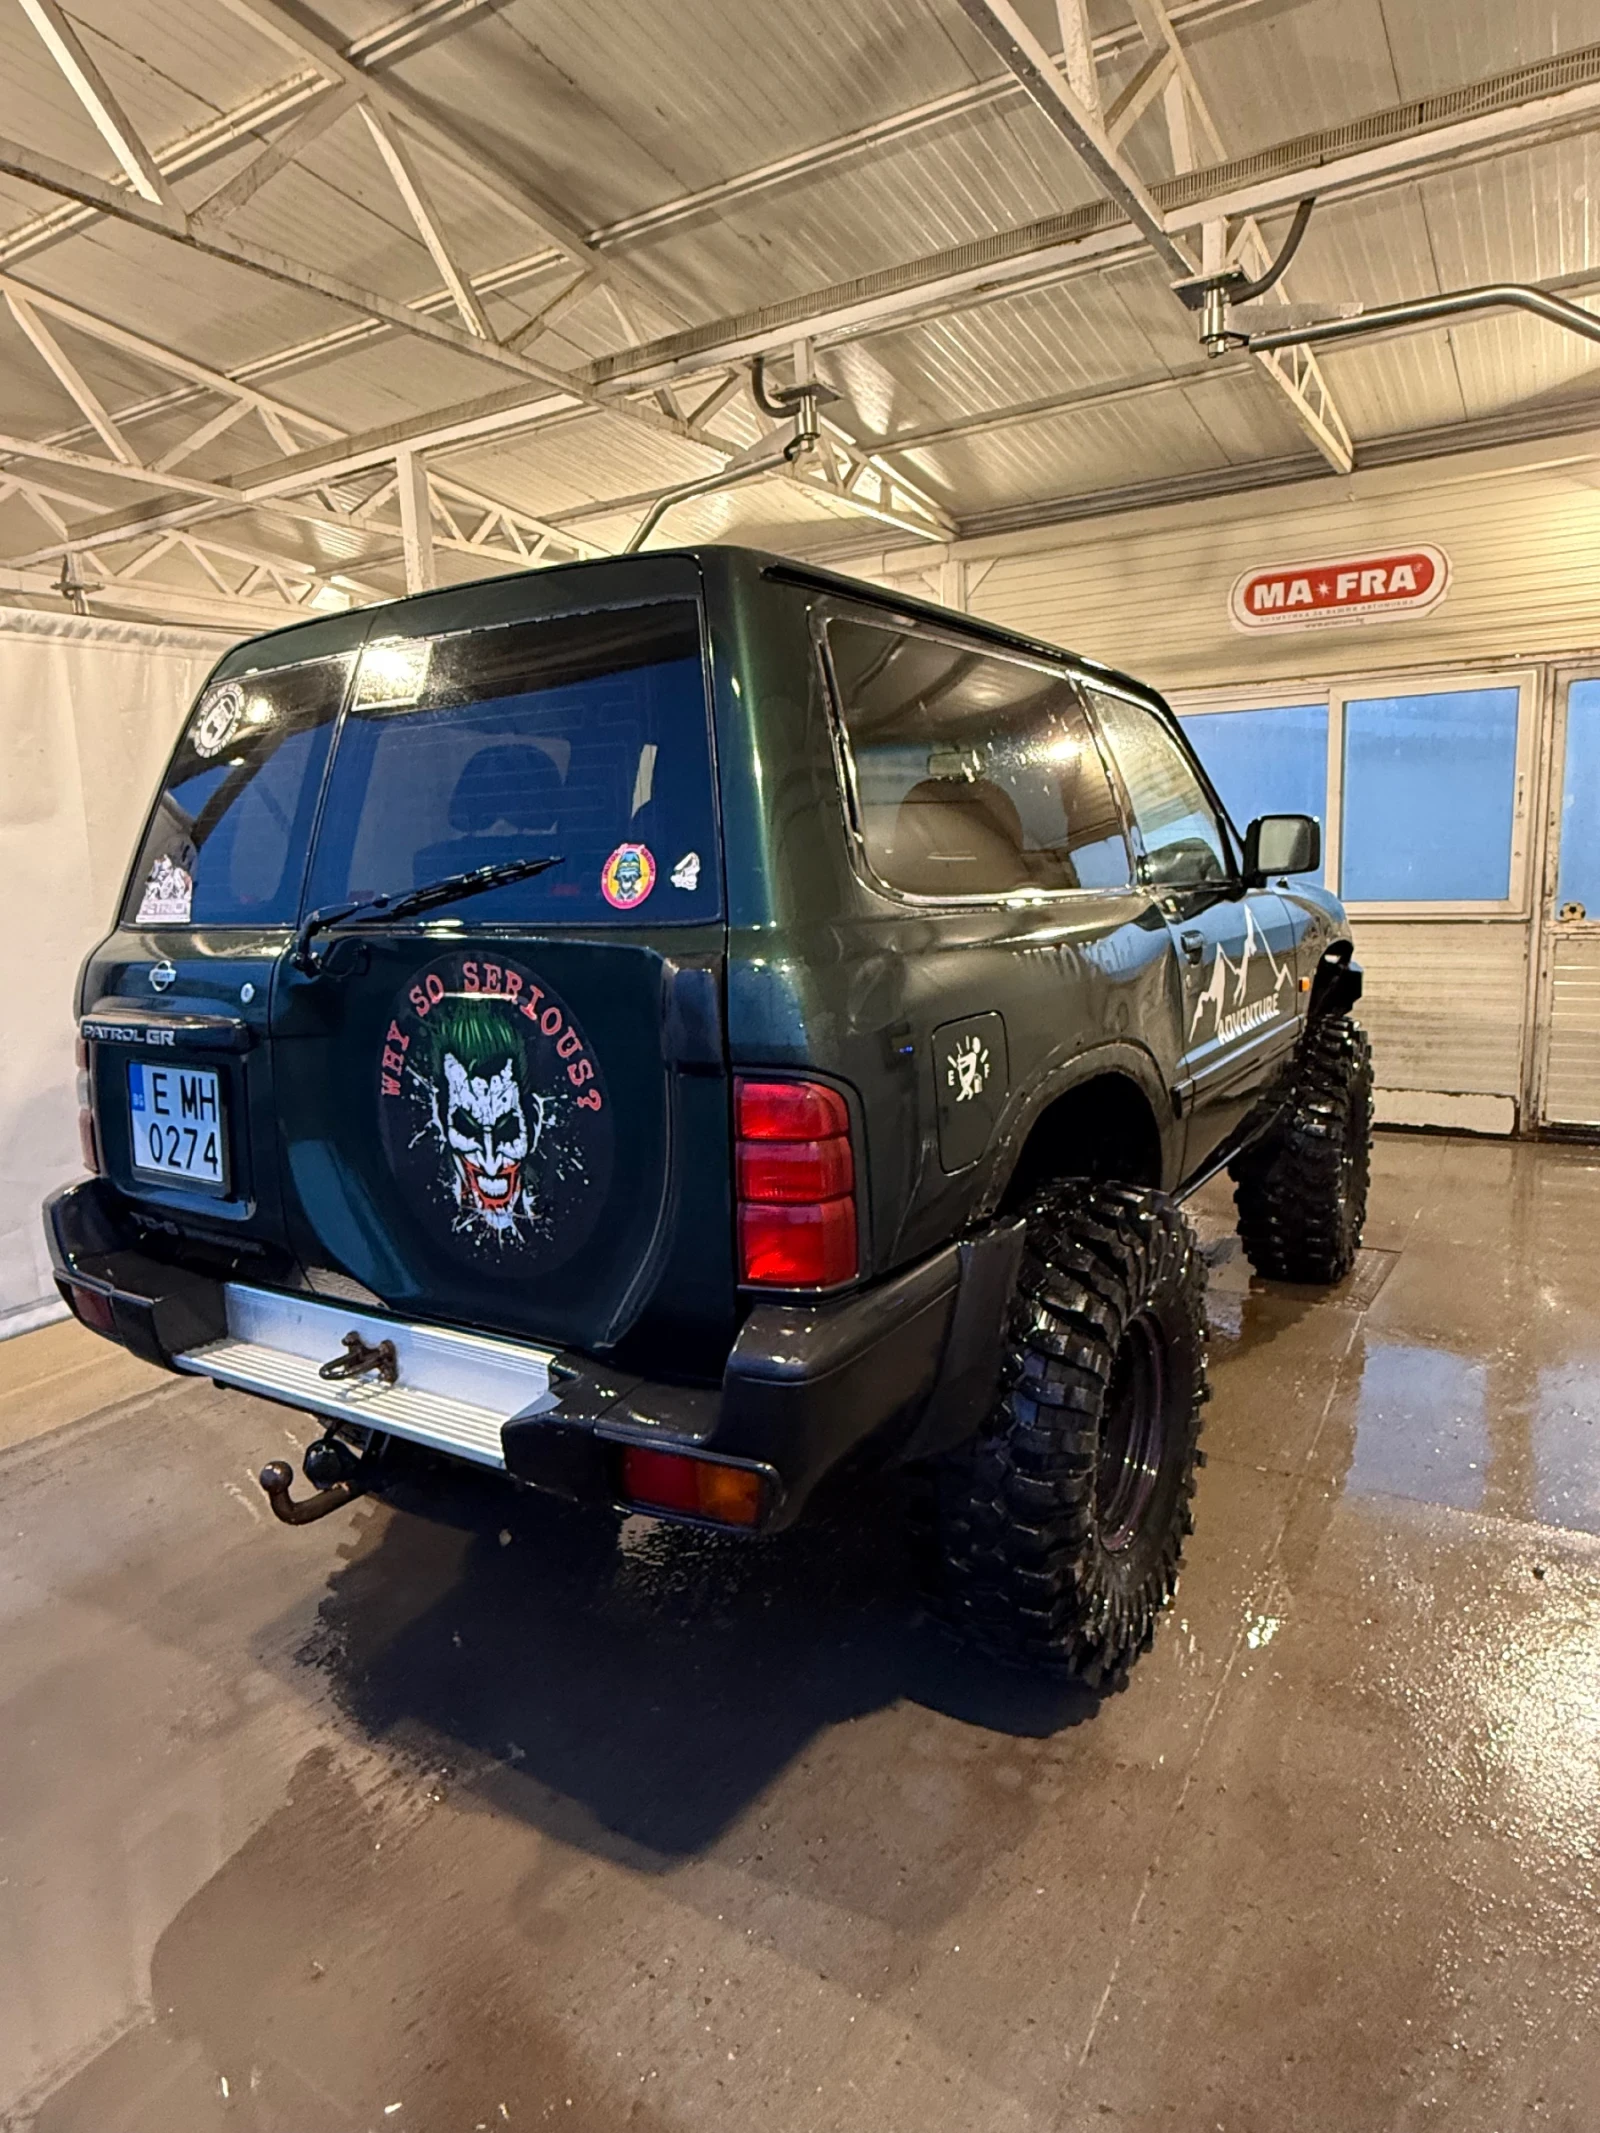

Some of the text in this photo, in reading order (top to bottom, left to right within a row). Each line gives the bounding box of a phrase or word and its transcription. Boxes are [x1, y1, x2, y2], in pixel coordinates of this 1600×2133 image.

[1253, 564, 1417, 610] MA FRA
[83, 1024, 176, 1046] PATROL GR
[381, 961, 602, 1112] WHY SO SERIOUS?
[1216, 992, 1281, 1046] ADVENTURE
[947, 1069, 955, 1087] E
[983, 1063, 990, 1079] F
[152, 1072, 217, 1123] E MH
[149, 1123, 219, 1175] 0274
